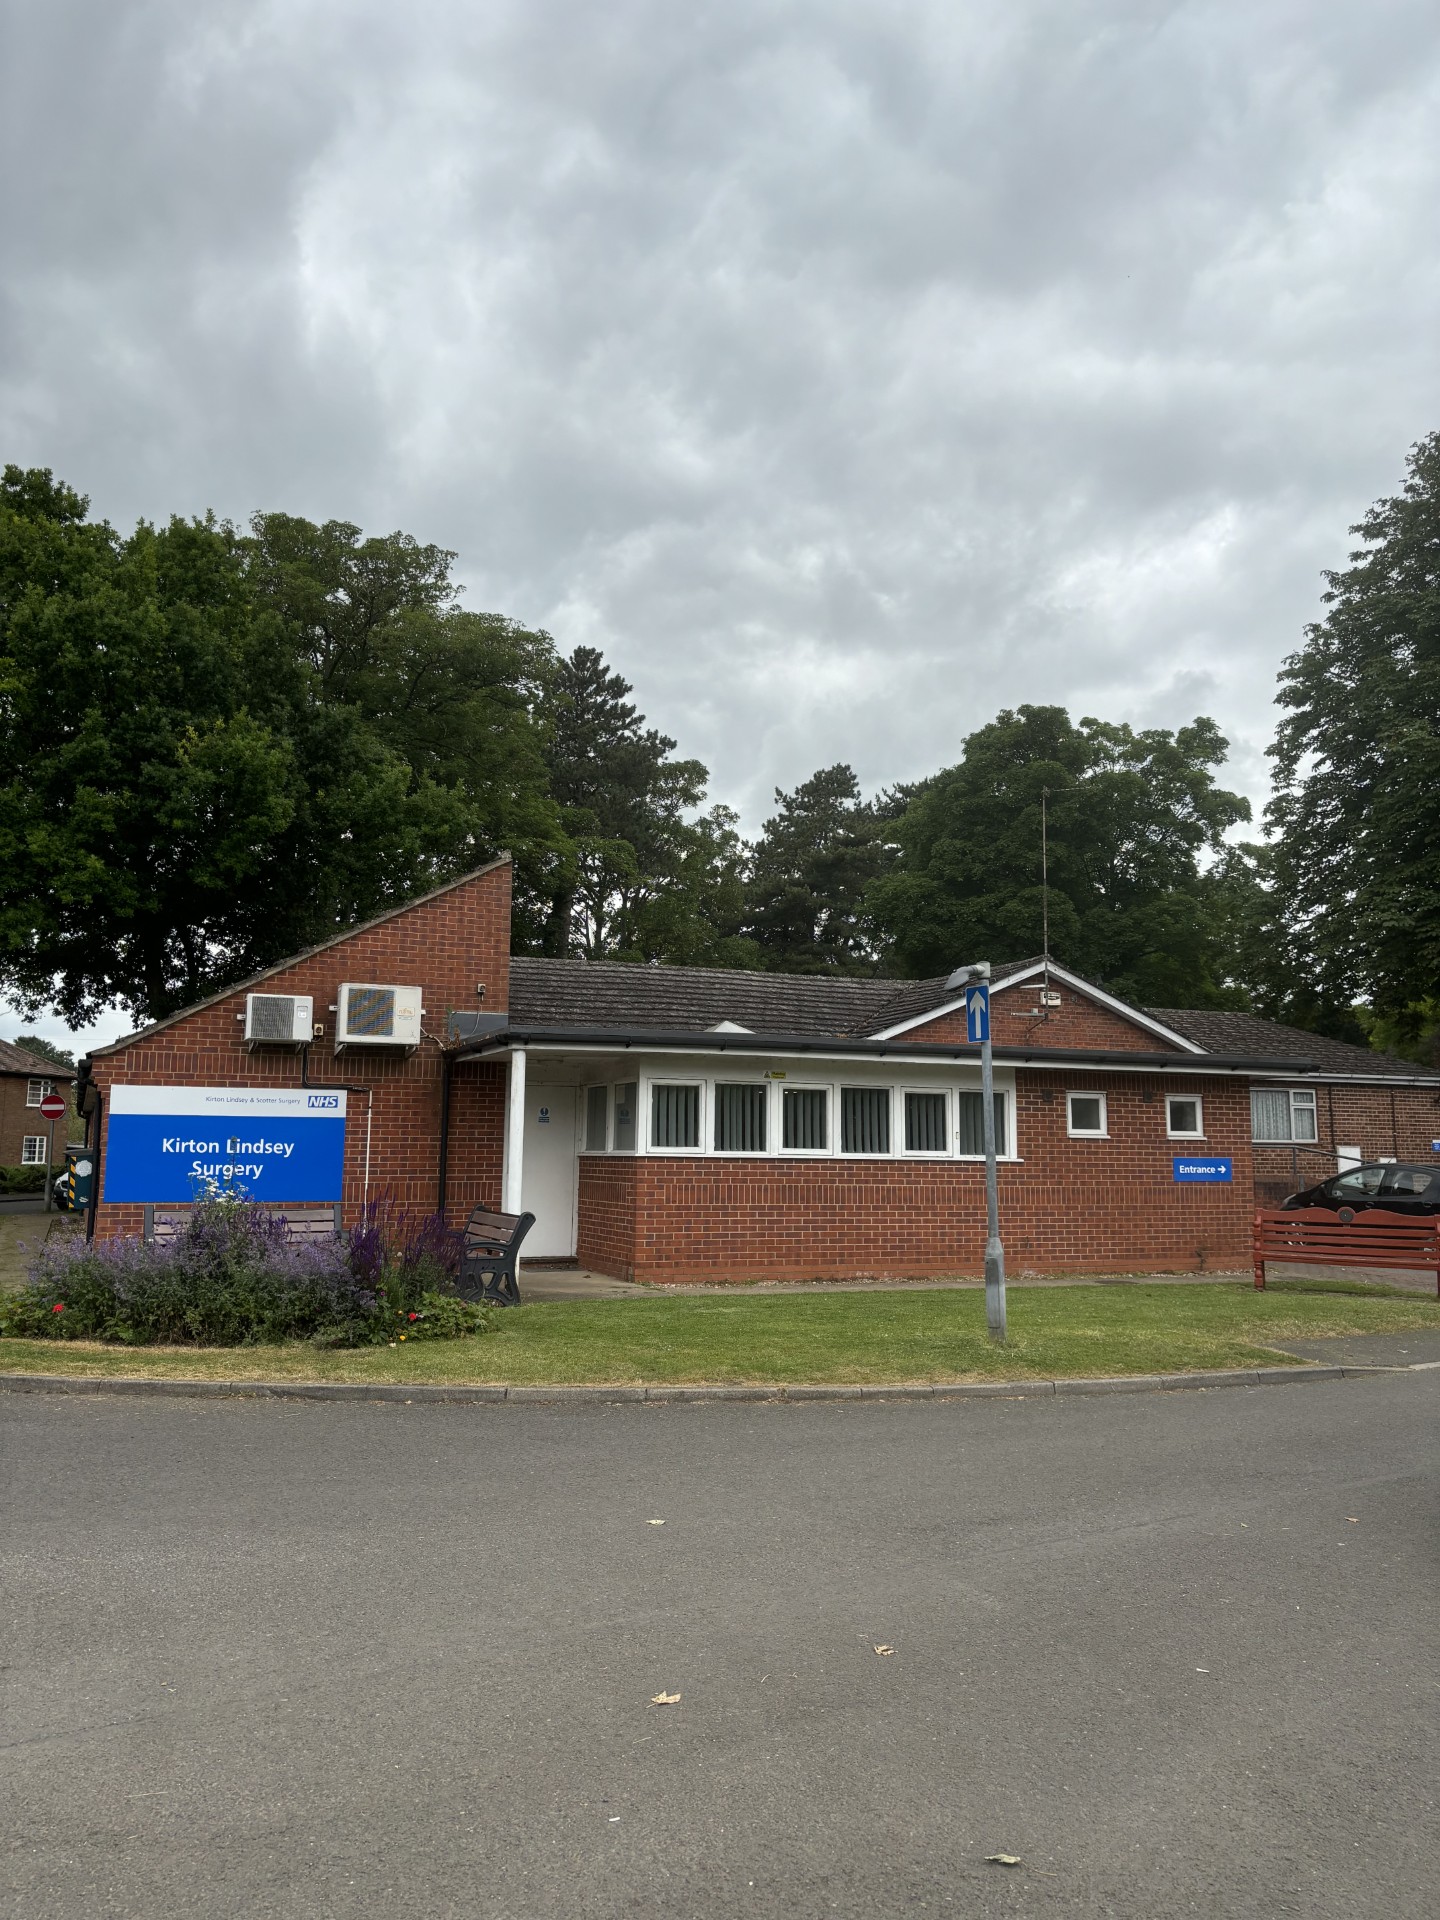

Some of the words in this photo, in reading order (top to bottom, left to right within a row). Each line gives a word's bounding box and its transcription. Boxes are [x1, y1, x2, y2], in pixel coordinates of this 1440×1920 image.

[308, 1096, 338, 1108] NHS
[162, 1138, 220, 1153] Kirton
[226, 1138, 295, 1158] Lindsey
[192, 1160, 264, 1180] Surgery
[1179, 1165, 1216, 1174] Entrance
